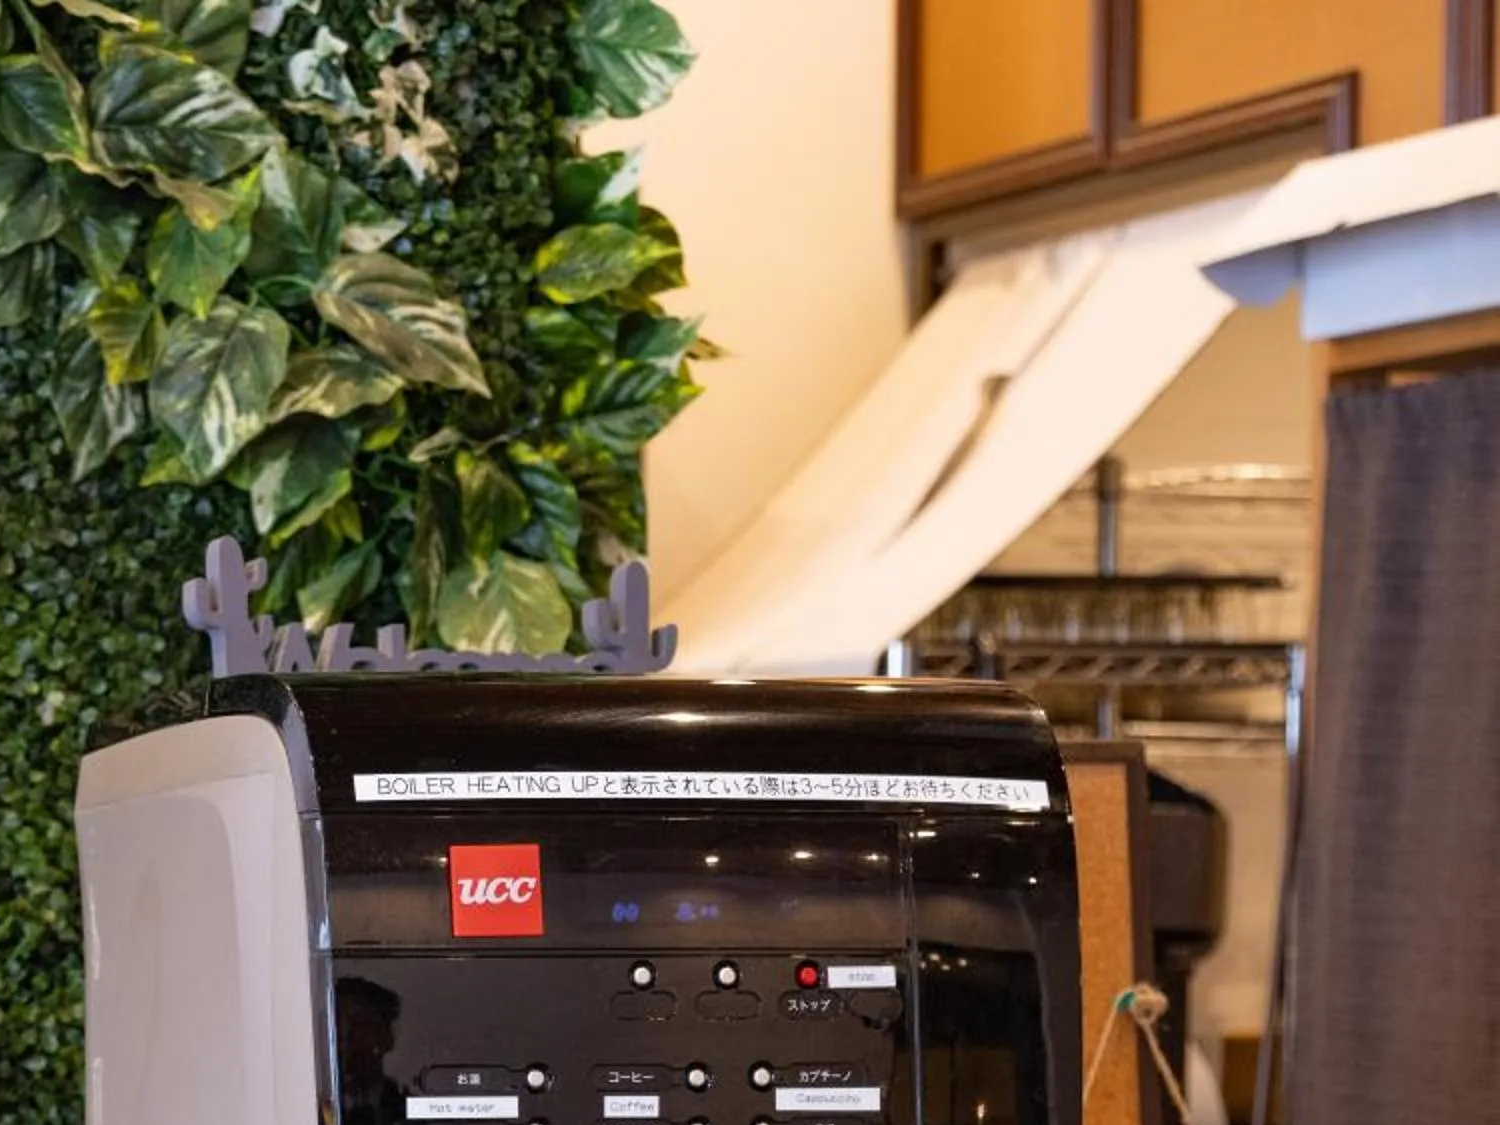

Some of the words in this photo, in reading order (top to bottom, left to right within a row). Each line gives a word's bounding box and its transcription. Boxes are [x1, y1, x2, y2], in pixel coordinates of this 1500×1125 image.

[376, 777, 455, 795] BOILER
[467, 775, 561, 794] HEATING
[607, 1071, 655, 1084] コーヒー
[609, 1101, 655, 1113] Coffee
